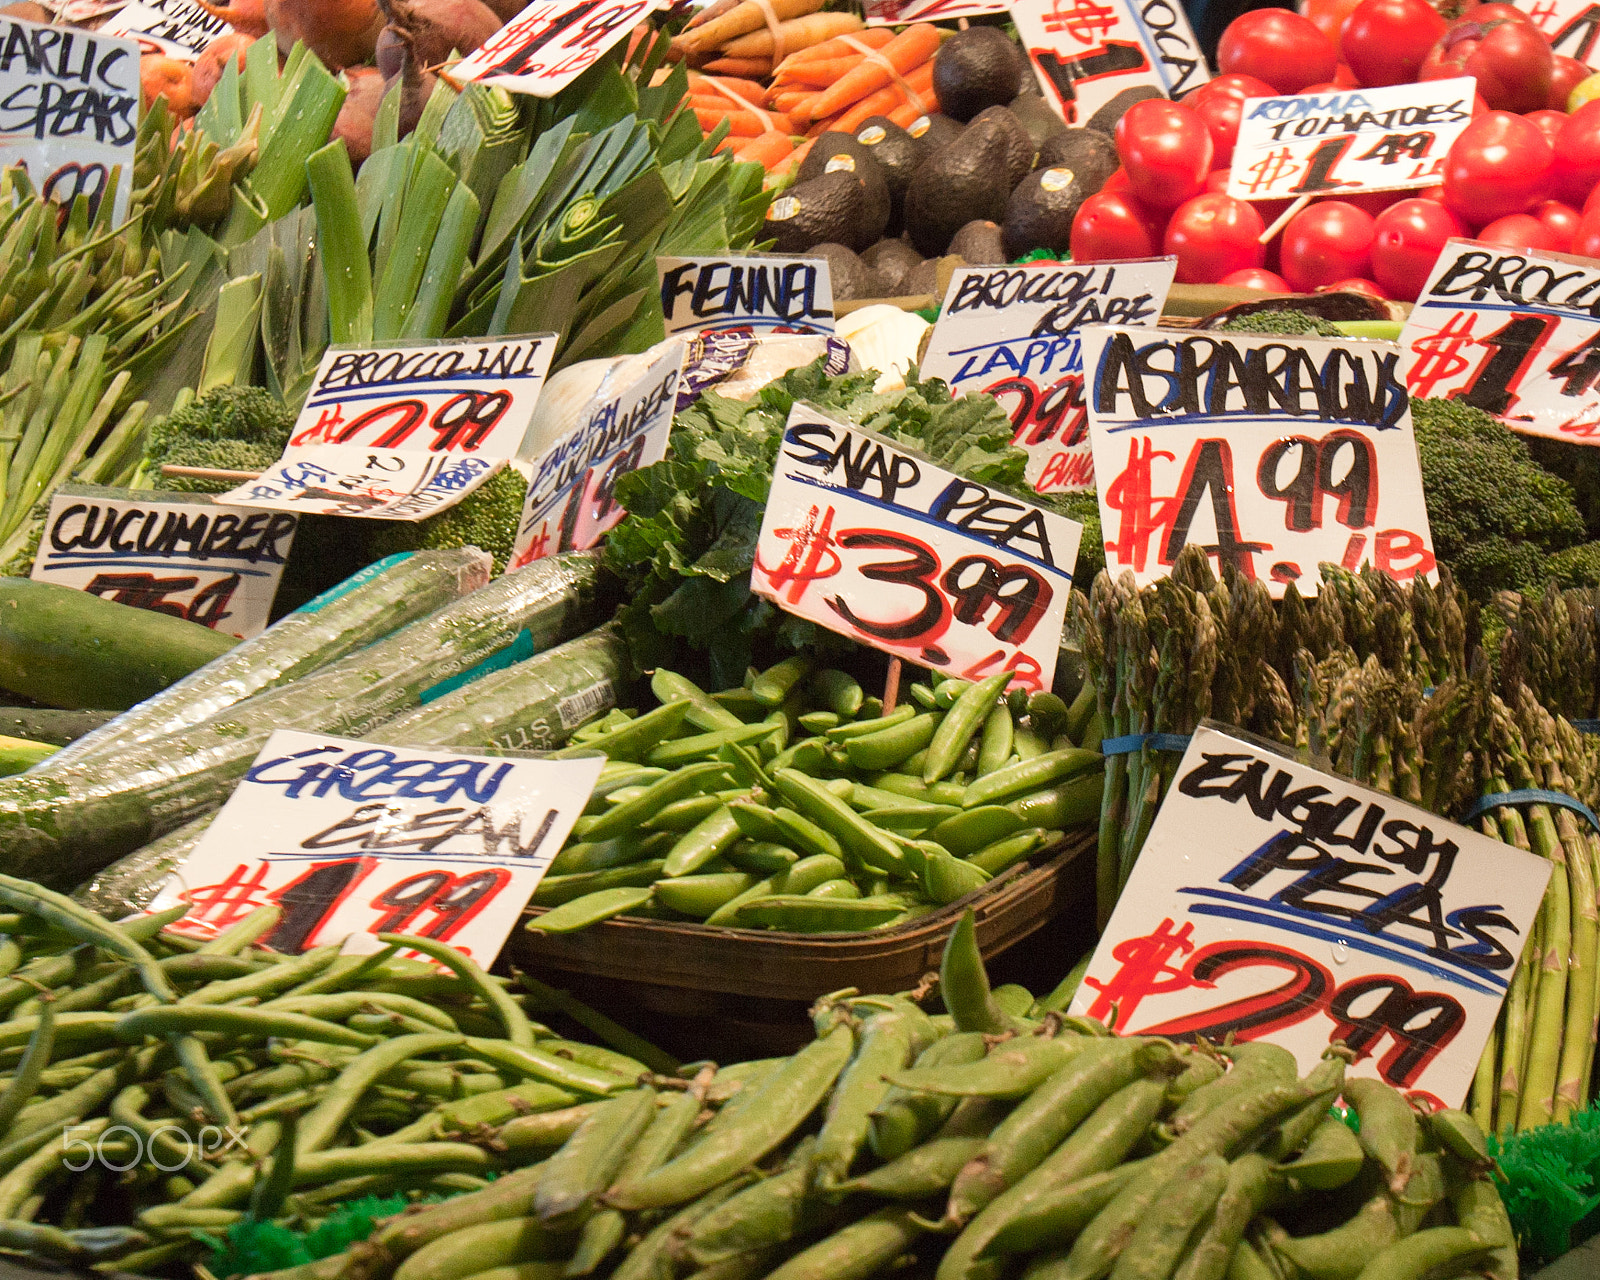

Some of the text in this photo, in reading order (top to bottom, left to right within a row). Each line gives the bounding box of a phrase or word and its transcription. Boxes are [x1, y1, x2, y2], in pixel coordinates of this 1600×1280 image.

[0, 20, 129, 90] ARLIC
[1142, 2, 1212, 101] OCA
[1247, 94, 1374, 121] ROMA
[1269, 99, 1471, 141] TOMATOES
[661, 262, 832, 323] FENNEL
[948, 267, 1115, 315] BROCCOLI
[1429, 251, 1600, 317] BROCC
[319, 341, 541, 386] BROCCOLINI
[1094, 332, 1409, 428] ASPARAGUS
[531, 369, 677, 510] CUCUMBER
[783, 423, 1056, 567] SNAP PEA
[50, 504, 298, 562] CUCUMBER
[246, 746, 515, 803] GREEN
[301, 803, 560, 857] BEAN
[1178, 752, 1459, 887] ENGLISH
[1219, 830, 1521, 971] PEAS
